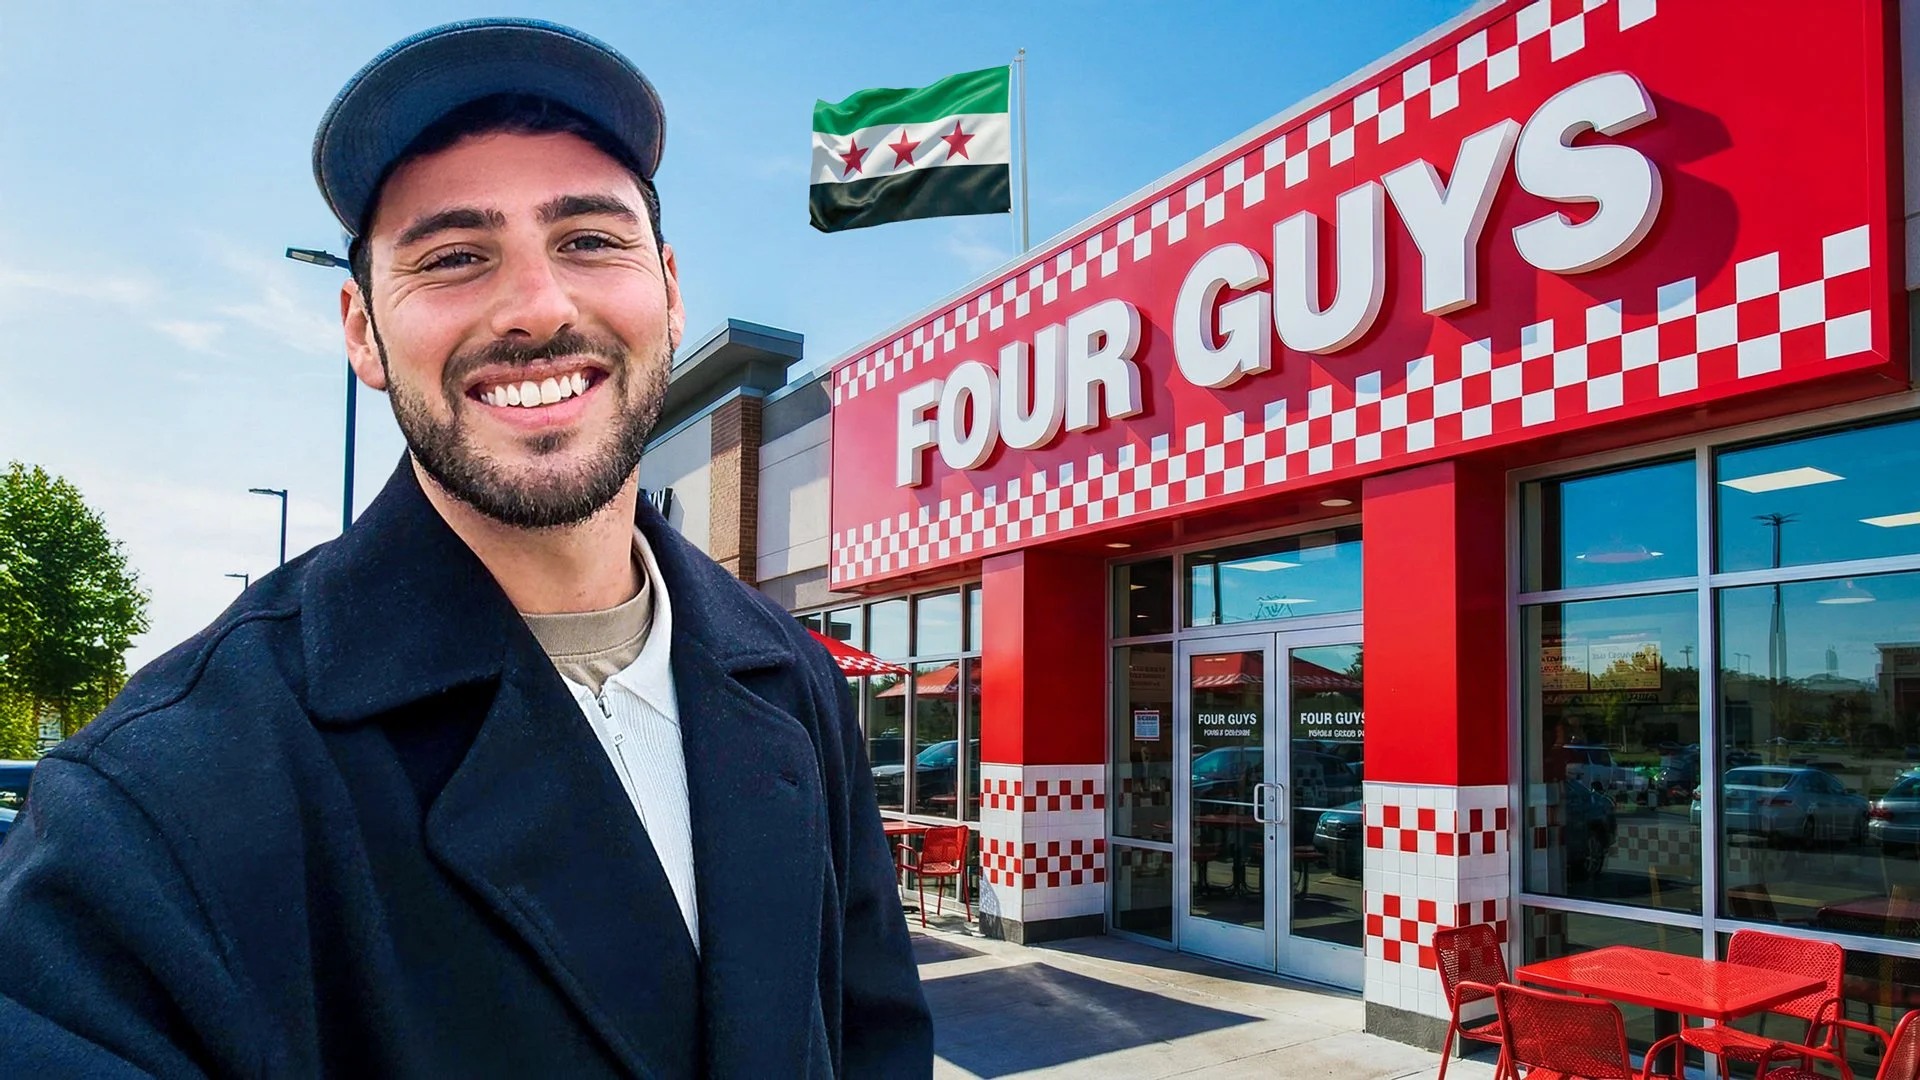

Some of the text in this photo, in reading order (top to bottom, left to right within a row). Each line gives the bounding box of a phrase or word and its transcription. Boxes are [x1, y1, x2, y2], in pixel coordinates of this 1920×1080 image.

[897, 71, 1662, 488] FOUR GUYS
[1198, 713, 1257, 725] FOUR GUYS
[1300, 712, 1332, 725] FOUR
